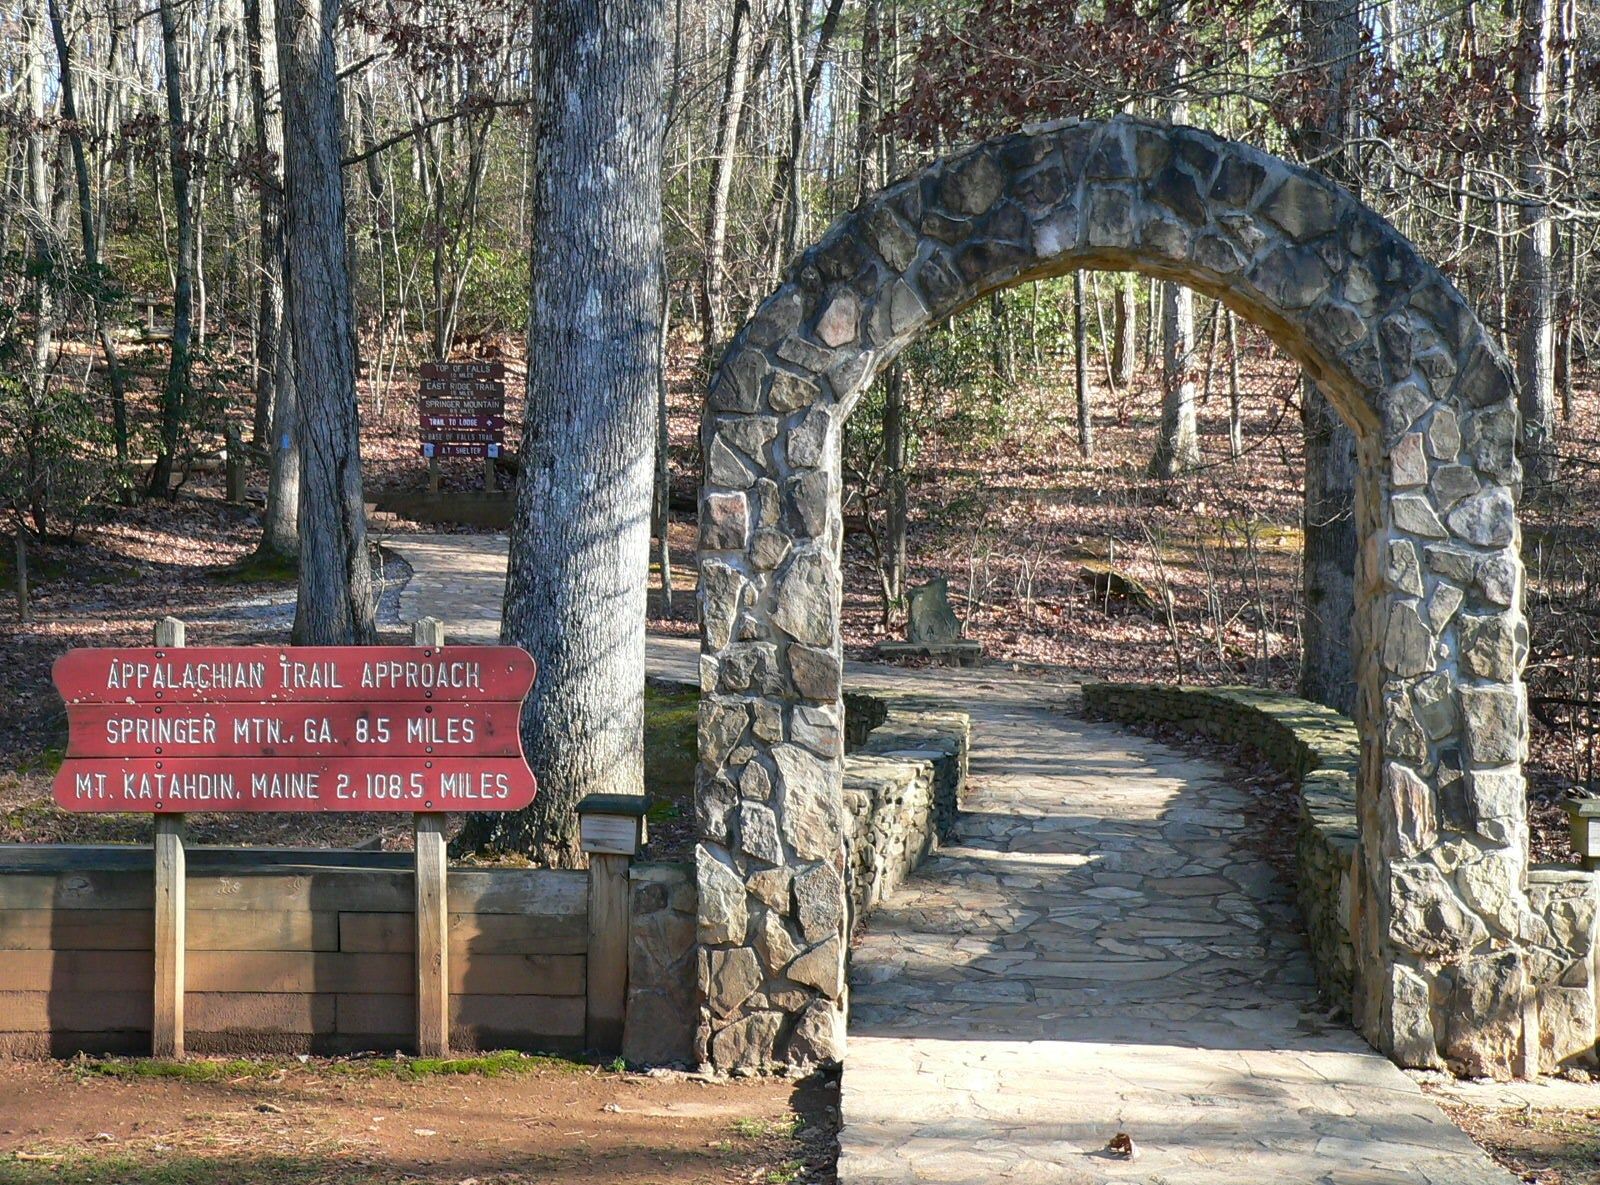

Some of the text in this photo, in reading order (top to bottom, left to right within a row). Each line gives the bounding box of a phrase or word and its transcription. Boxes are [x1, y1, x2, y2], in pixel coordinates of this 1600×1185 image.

[466, 365, 490, 373] FALLS
[107, 661, 481, 689] APPALACHIAN TRAIL APPROACH
[106, 717, 217, 744] SPRINGER
[304, 717, 339, 744] GA.
[356, 717, 392, 744] 8.5
[407, 717, 476, 744] MILES
[75, 772, 115, 800] MT.
[251, 772, 320, 800] MAINE
[440, 772, 510, 800] MILES
